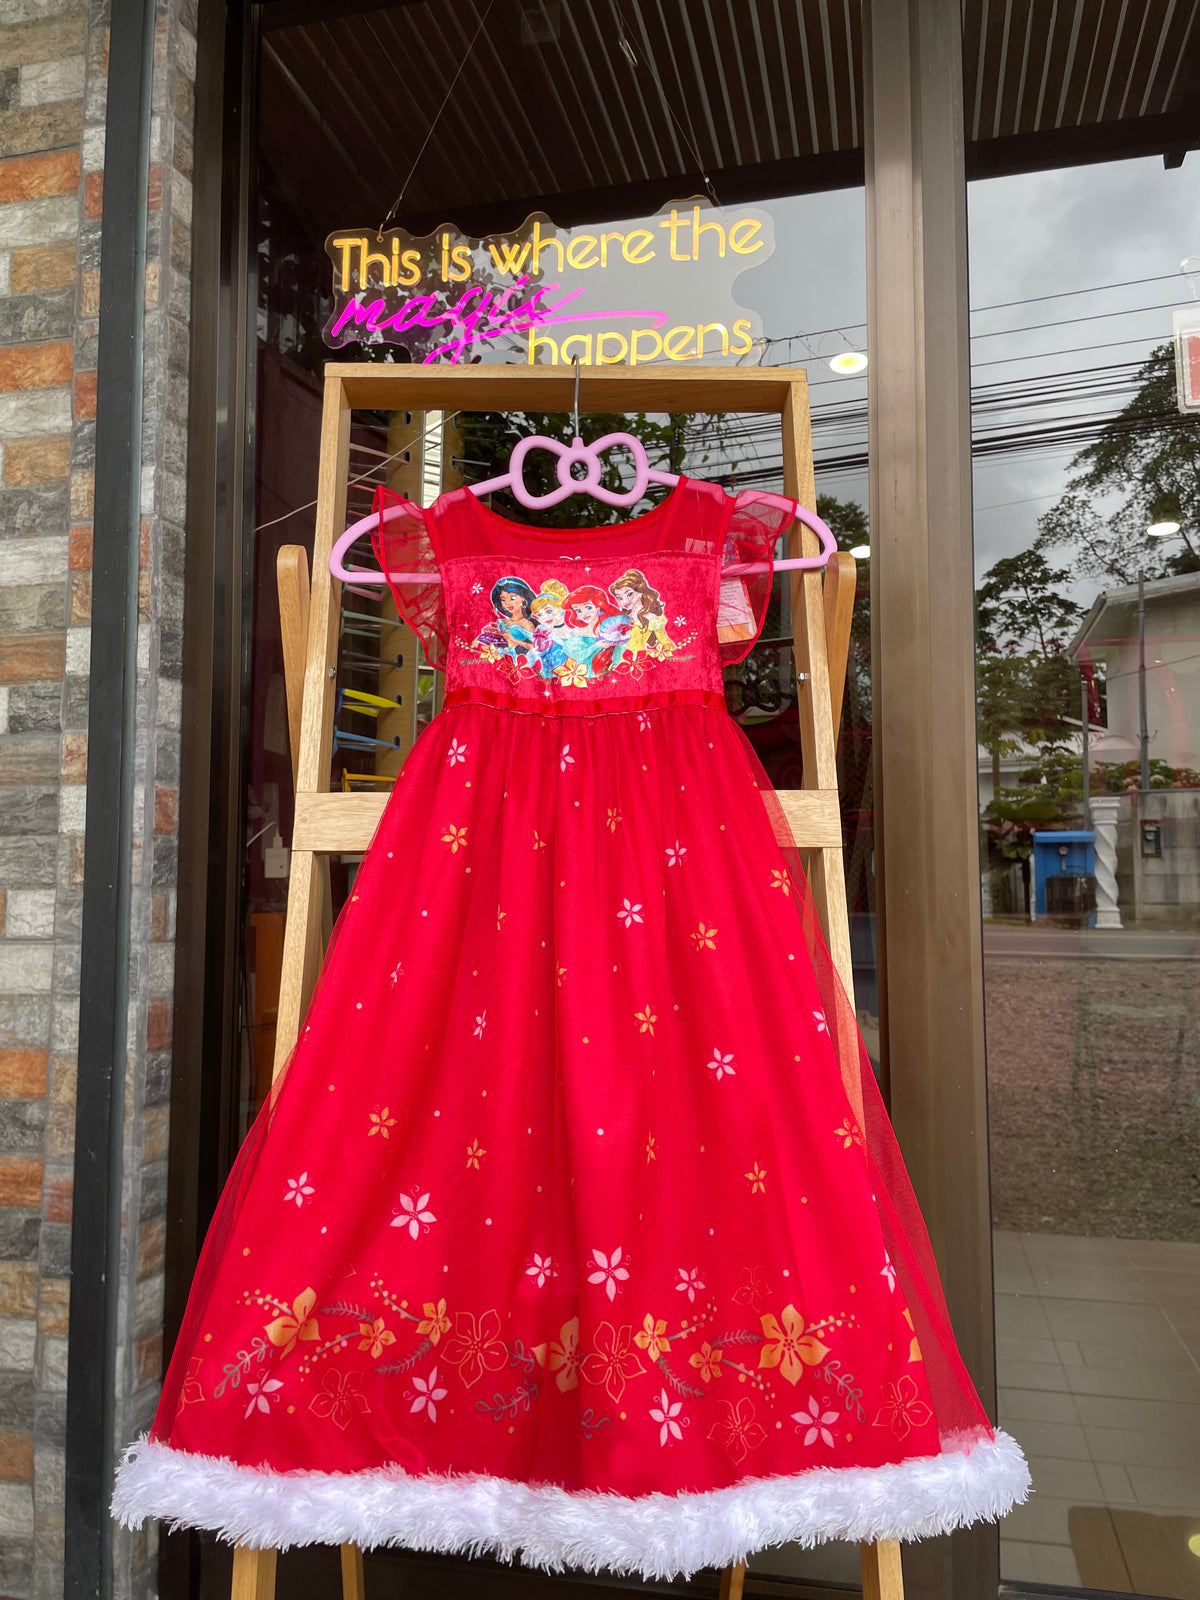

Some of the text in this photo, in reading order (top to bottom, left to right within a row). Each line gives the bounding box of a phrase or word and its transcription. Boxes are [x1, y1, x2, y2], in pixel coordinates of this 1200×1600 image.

[332, 205, 764, 292] This is where the
[331, 274, 668, 364] magic
[528, 319, 753, 366] happens
